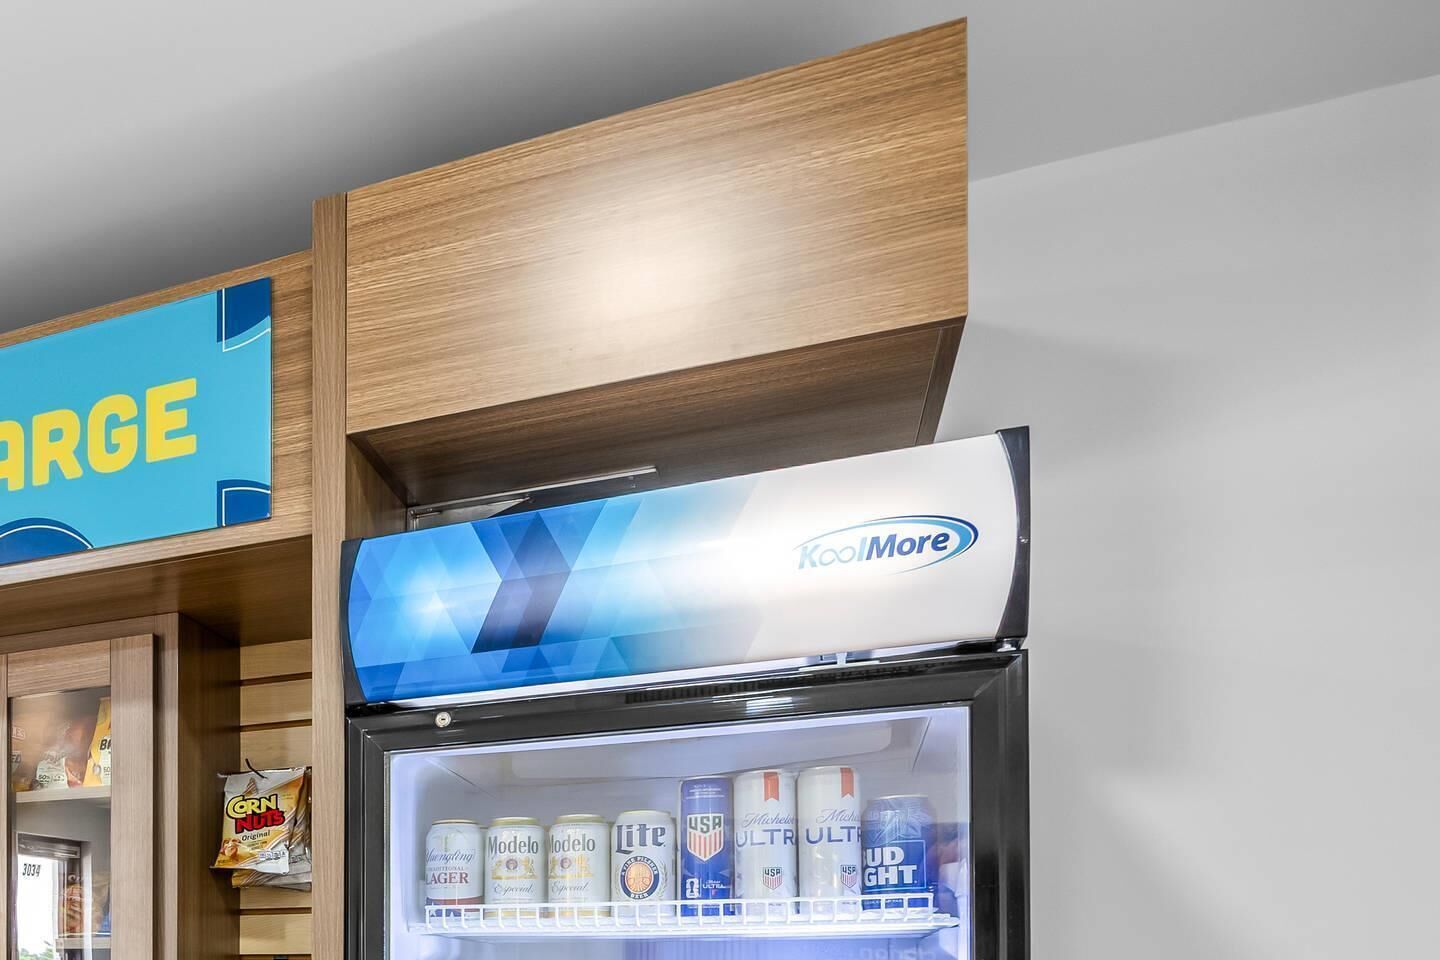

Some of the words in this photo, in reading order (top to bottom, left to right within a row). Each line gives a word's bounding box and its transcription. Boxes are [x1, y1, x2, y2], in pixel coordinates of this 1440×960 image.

[798, 533, 950, 570] KoolMore
[226, 794, 278, 819] CORN
[235, 810, 286, 833] NUTS
[689, 815, 722, 833] USA
[241, 830, 270, 842] Original
[488, 836, 539, 855] Modelo
[616, 824, 665, 855] Lite
[736, 829, 796, 848] ULTR
[863, 846, 904, 867] UD
[425, 872, 469, 886] LAGER
